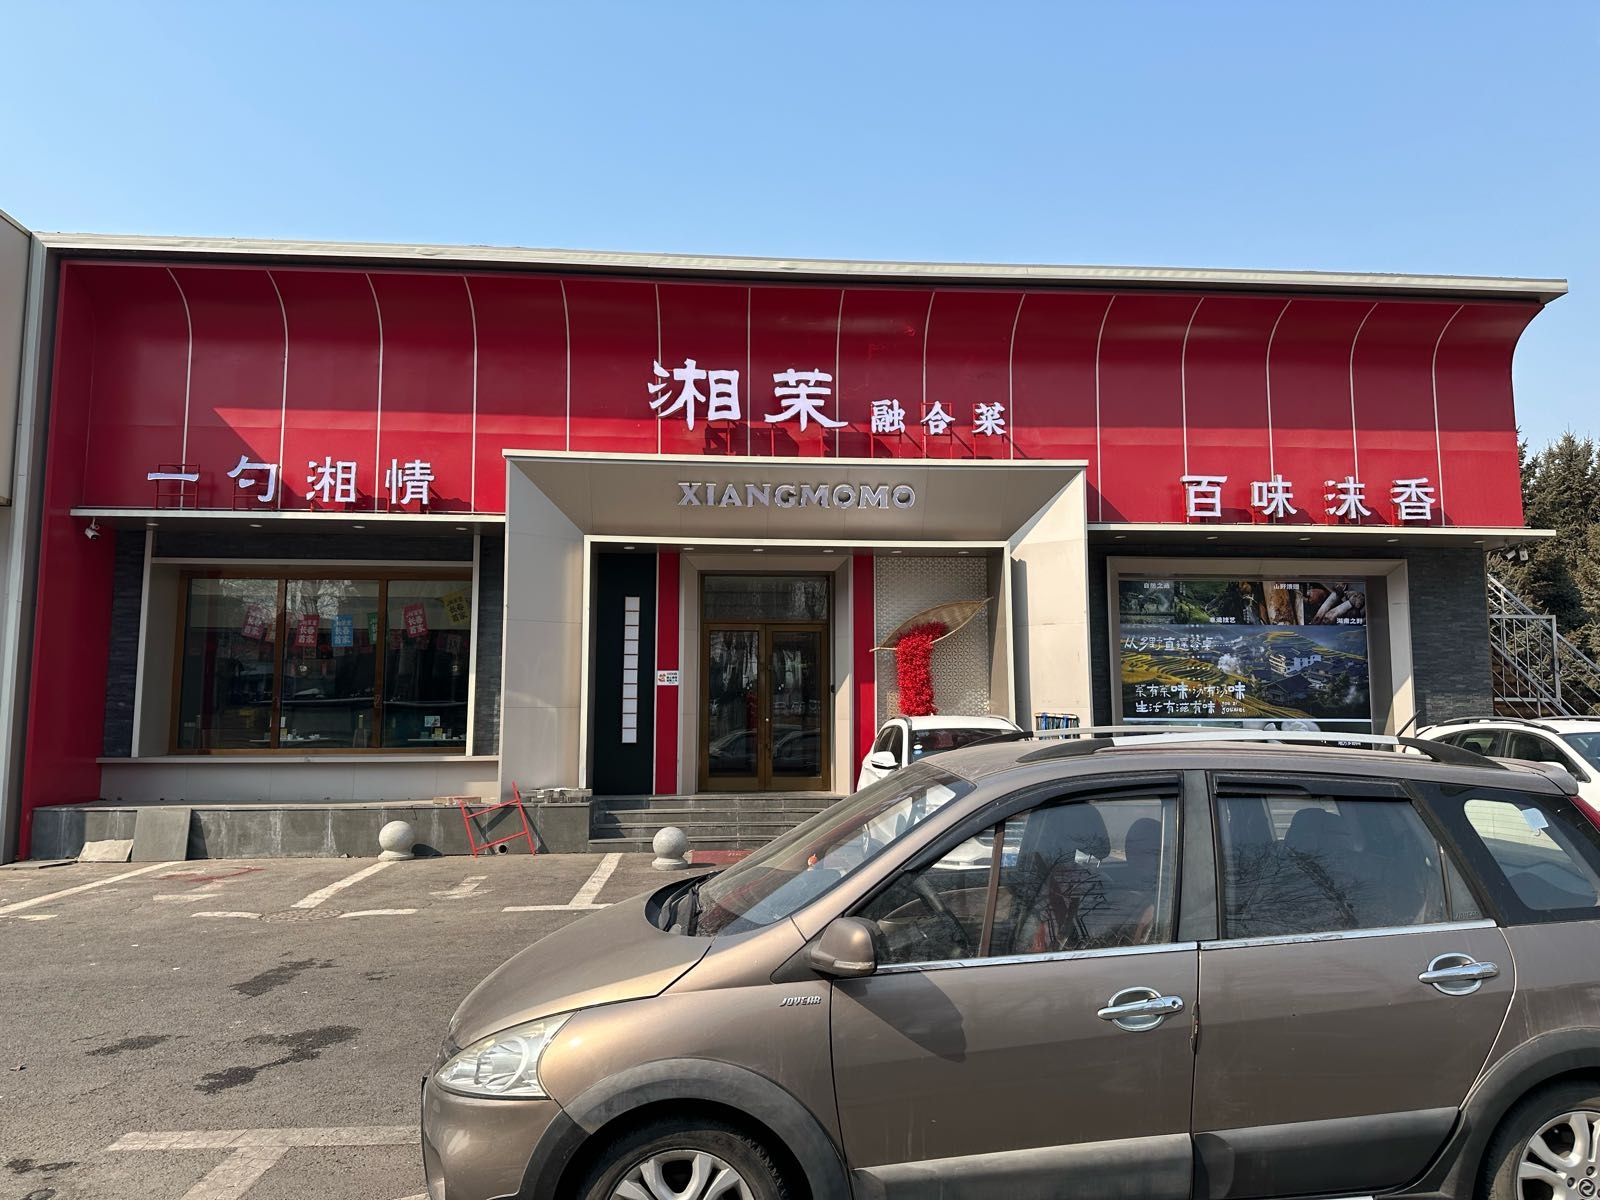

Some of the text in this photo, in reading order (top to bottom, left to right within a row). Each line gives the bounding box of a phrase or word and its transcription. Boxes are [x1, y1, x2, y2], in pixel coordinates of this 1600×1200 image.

[647, 358, 1007, 436] 湘茉 融合菜
[147, 455, 435, 505] 一勺湘情
[677, 482, 916, 509] XIANGMOMO
[1180, 474, 1436, 521] 百味沫香
[780, 996, 821, 1007] JOYEAR
